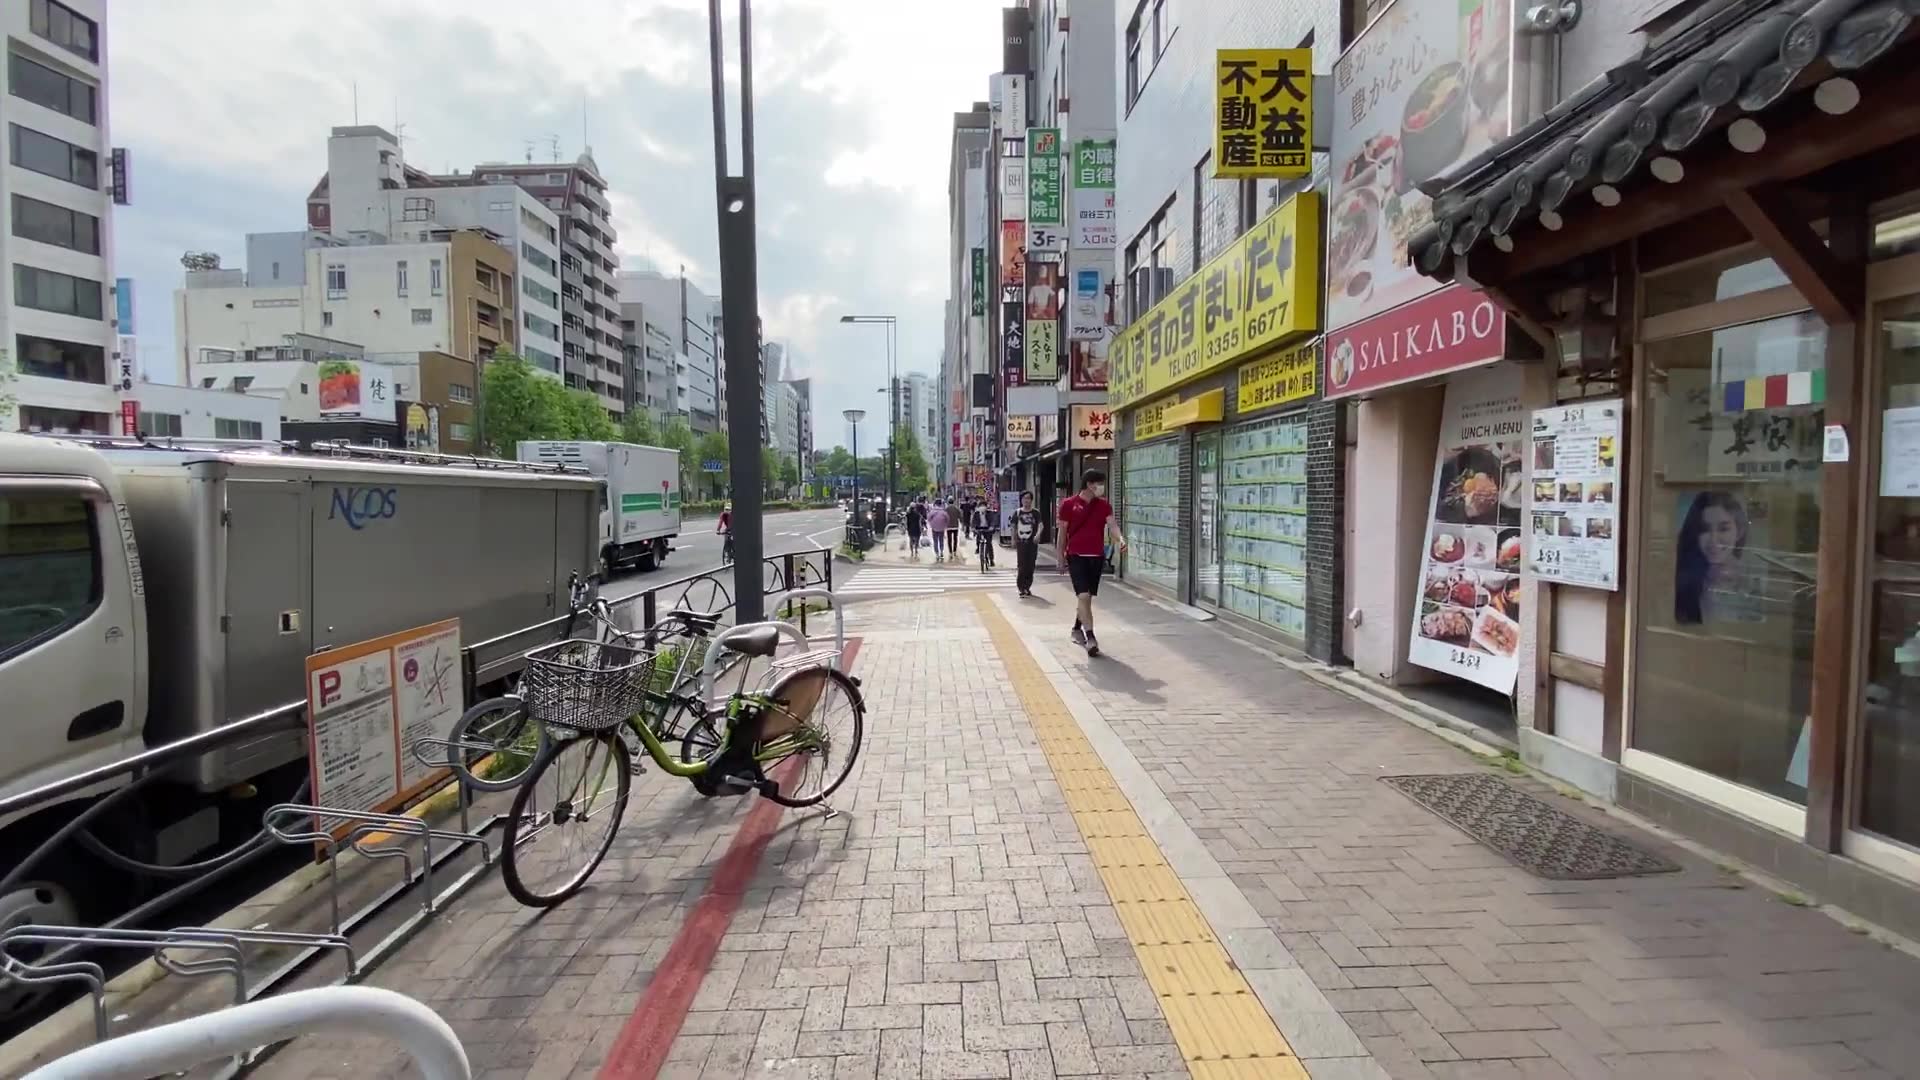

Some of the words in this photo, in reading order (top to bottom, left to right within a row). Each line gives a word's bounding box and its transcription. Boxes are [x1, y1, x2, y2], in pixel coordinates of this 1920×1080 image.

[1221, 61, 1257, 167] 不動産
[1261, 59, 1307, 151] 大益
[1261, 152, 1306, 166] だいます
[1031, 157, 1048, 218] 整体院
[1049, 158, 1058, 218] 四谷三丁目
[1080, 210, 1115, 219] 四谷三丁
[1032, 230, 1056, 247] 3F
[1007, 321, 1022, 349] 大地
[1206, 328, 1239, 360] 3355
[1248, 300, 1288, 340] 6677
[1359, 301, 1494, 371] SAIKABO
[370, 378, 387, 401] 梵
[1461, 425, 1492, 441] LUNCH
[1493, 421, 1522, 437] MENU
[319, 670, 341, 708] P
